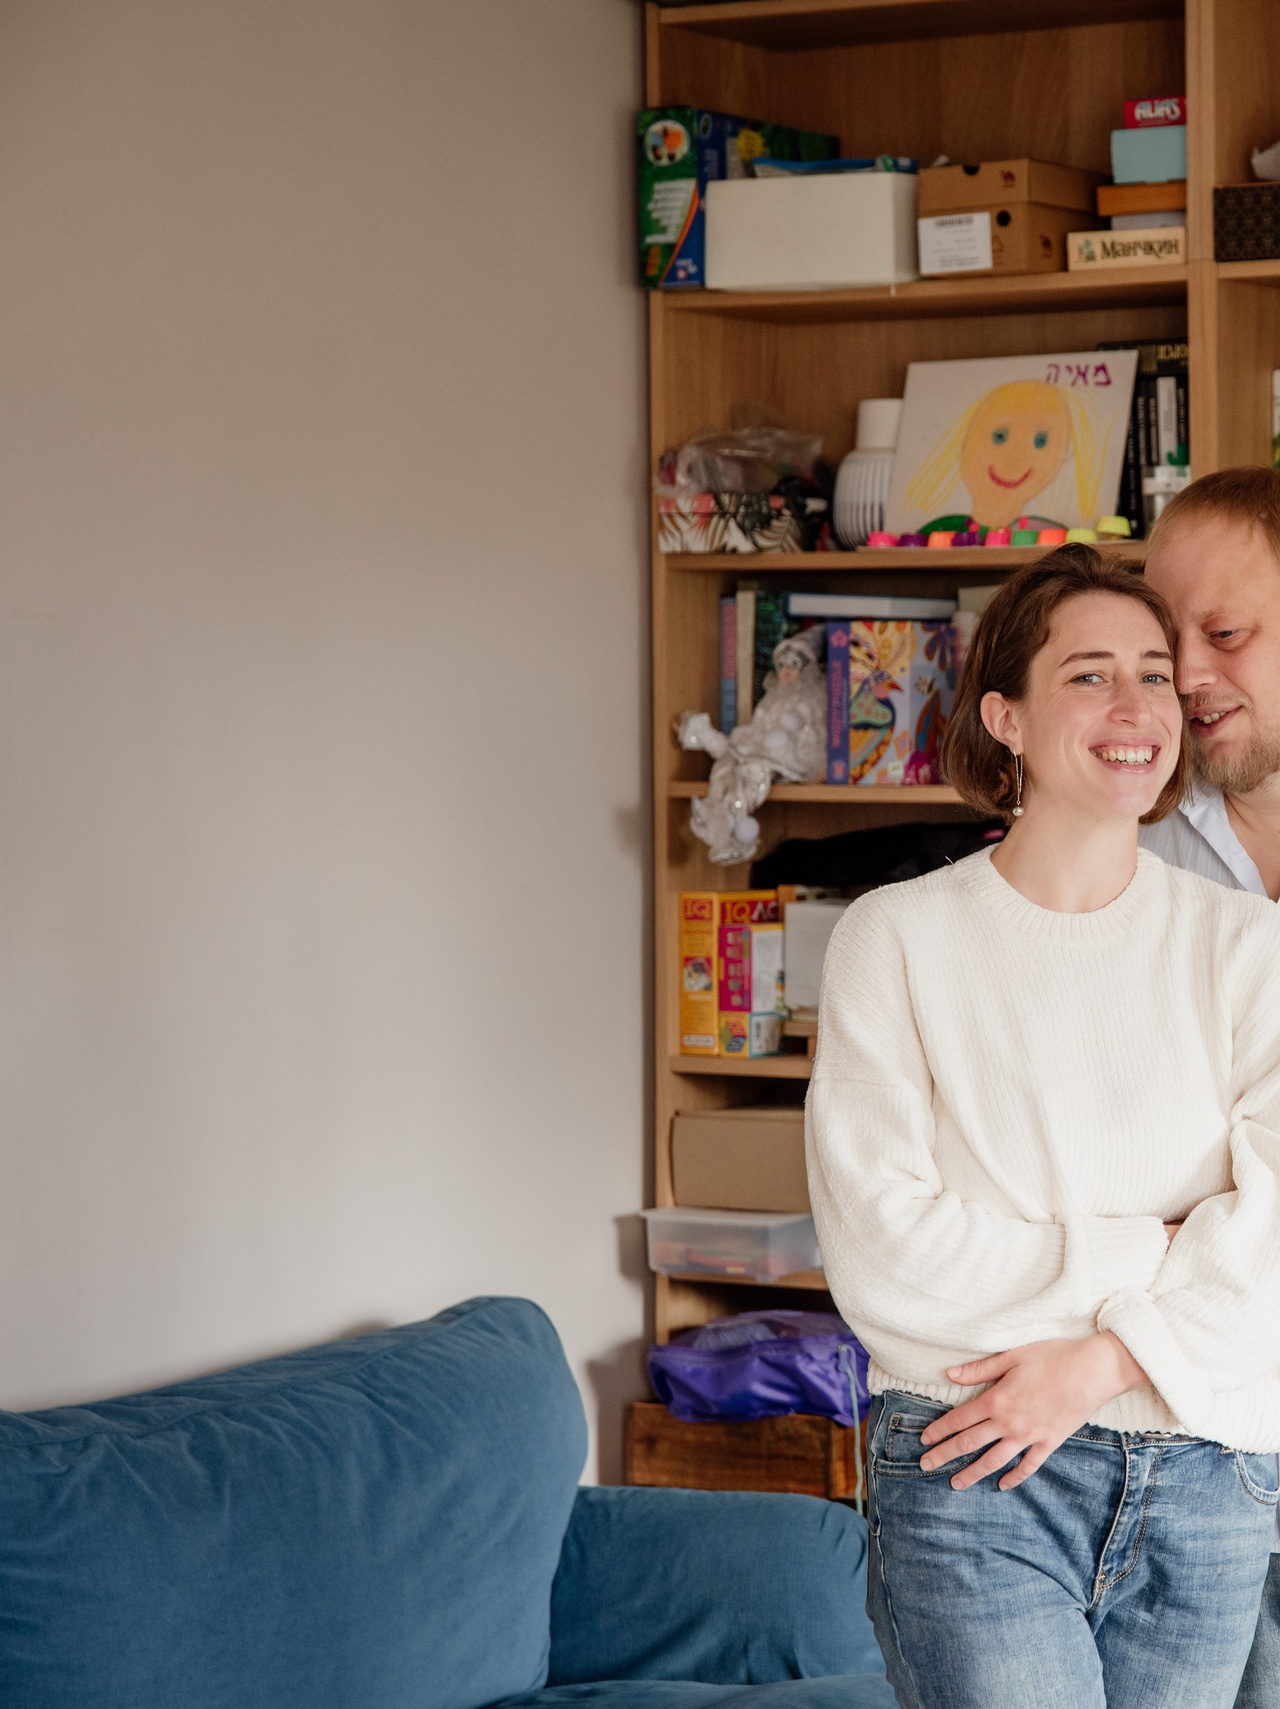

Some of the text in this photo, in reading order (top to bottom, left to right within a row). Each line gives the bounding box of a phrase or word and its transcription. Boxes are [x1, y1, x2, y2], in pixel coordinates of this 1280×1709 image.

[1135, 98, 1180, 120] ALIAS
[1101, 238, 1179, 261] Манчкин
[1046, 362, 1112, 388] מאיה
[684, 898, 713, 917] IQ
[724, 901, 750, 923] IQ
